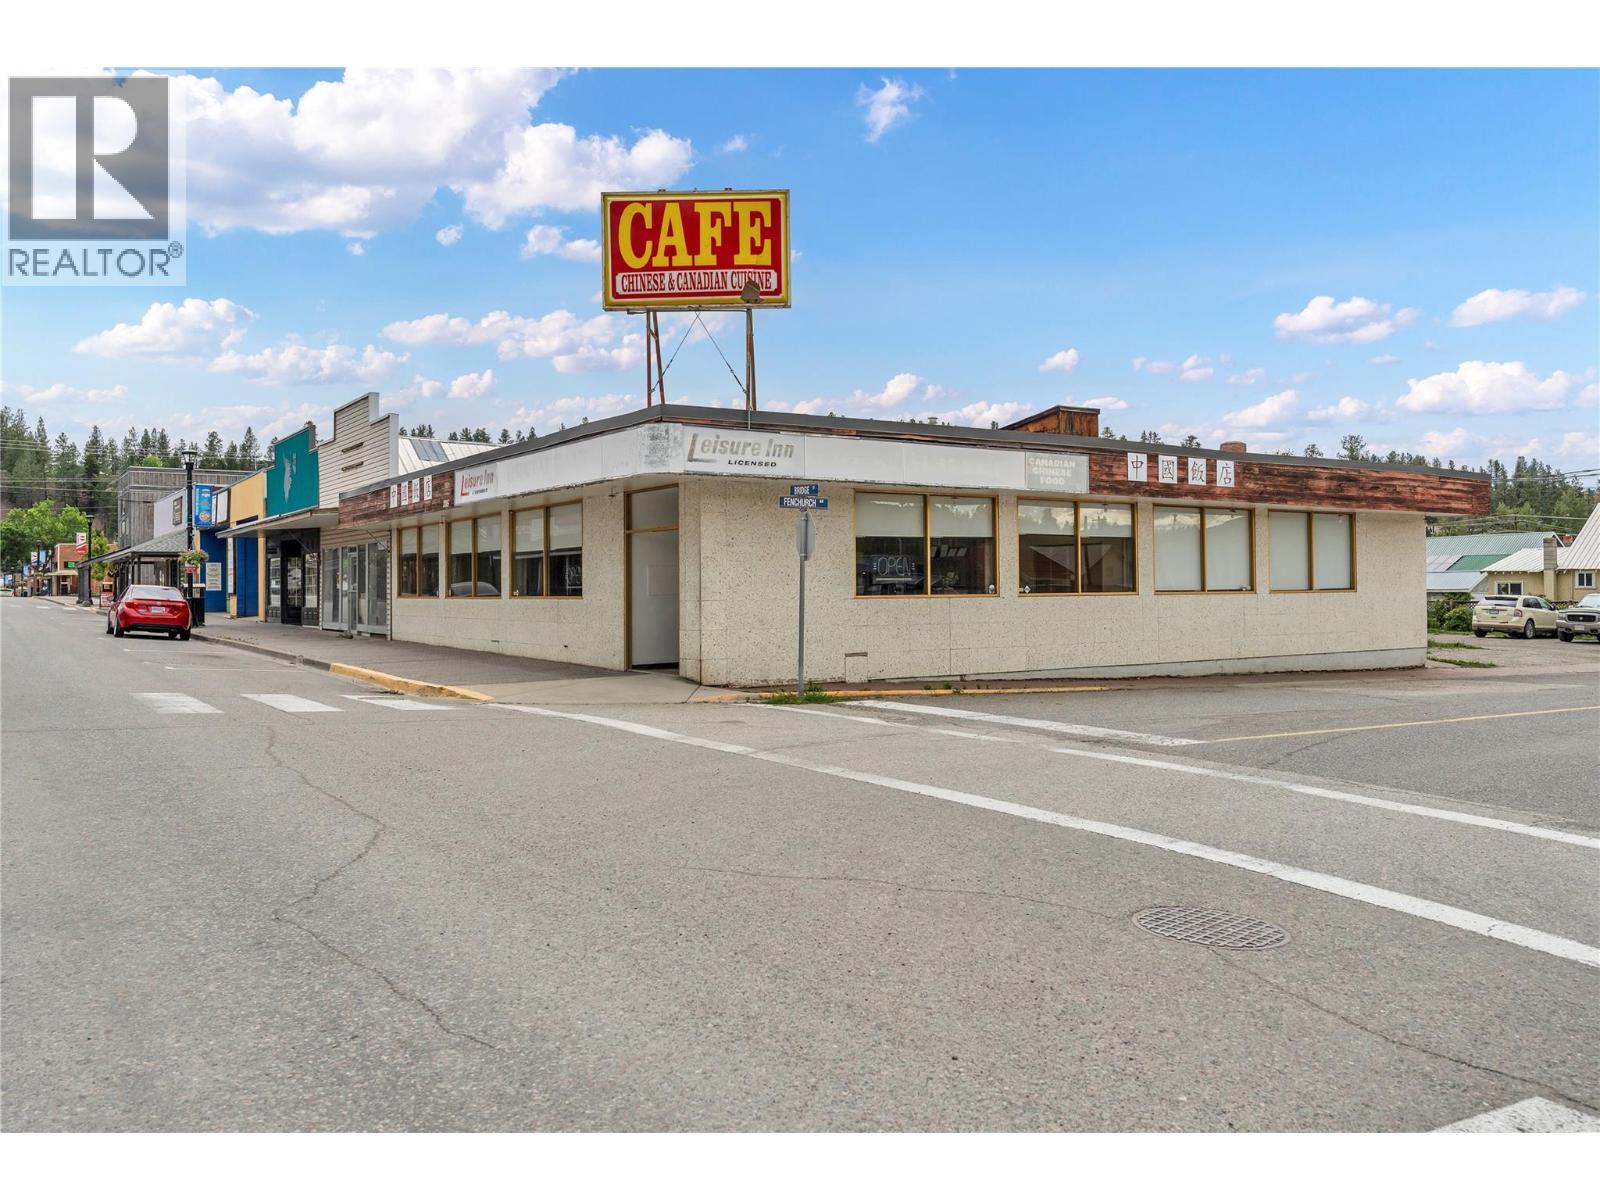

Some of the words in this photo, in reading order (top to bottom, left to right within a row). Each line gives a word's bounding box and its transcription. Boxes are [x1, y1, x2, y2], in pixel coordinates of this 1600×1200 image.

[618, 200, 772, 269] CAFE
[621, 273, 666, 293] CHINESE
[668, 273, 675, 291] &
[676, 271, 728, 291] CANADIAN
[687, 433, 763, 463] Leisure
[765, 438, 795, 459] Inn
[728, 459, 777, 468] LICENSED
[1131, 455, 1232, 486] 中國飯店
[460, 474, 483, 496] Leisure
[793, 486, 810, 495] BRIDGE
[783, 497, 817, 508] FENCHURCH
[877, 556, 912, 577] OPEN
